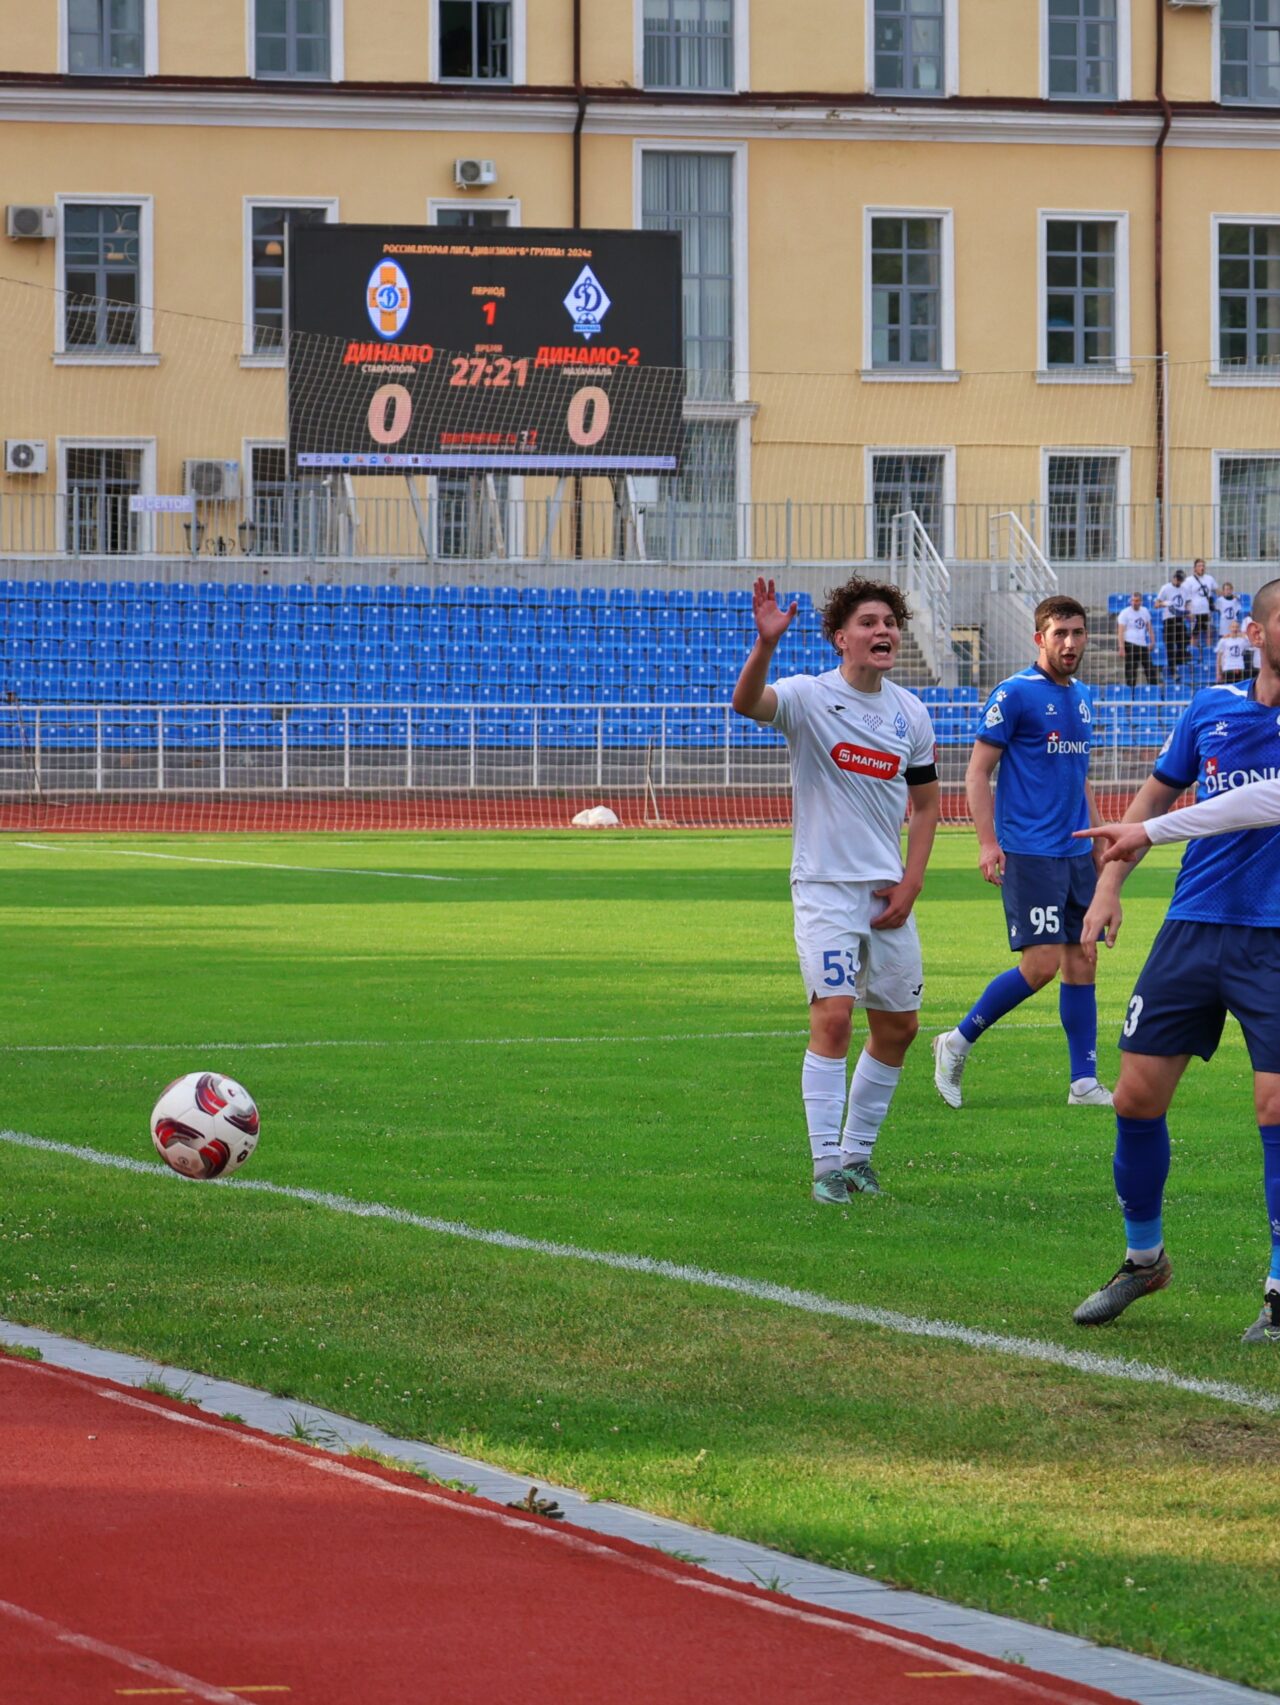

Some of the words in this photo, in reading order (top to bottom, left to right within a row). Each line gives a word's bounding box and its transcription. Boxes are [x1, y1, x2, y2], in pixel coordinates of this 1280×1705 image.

[482, 302, 496, 326] 1
[344, 343, 433, 365] ДИНАМО
[535, 346, 640, 368] ДИНАМО-2
[450, 358, 529, 387] 27:21
[367, 383, 412, 445] 0
[567, 386, 610, 446] 0
[851, 753, 894, 772] МАГНИТ
[1030, 906, 1059, 935] 95
